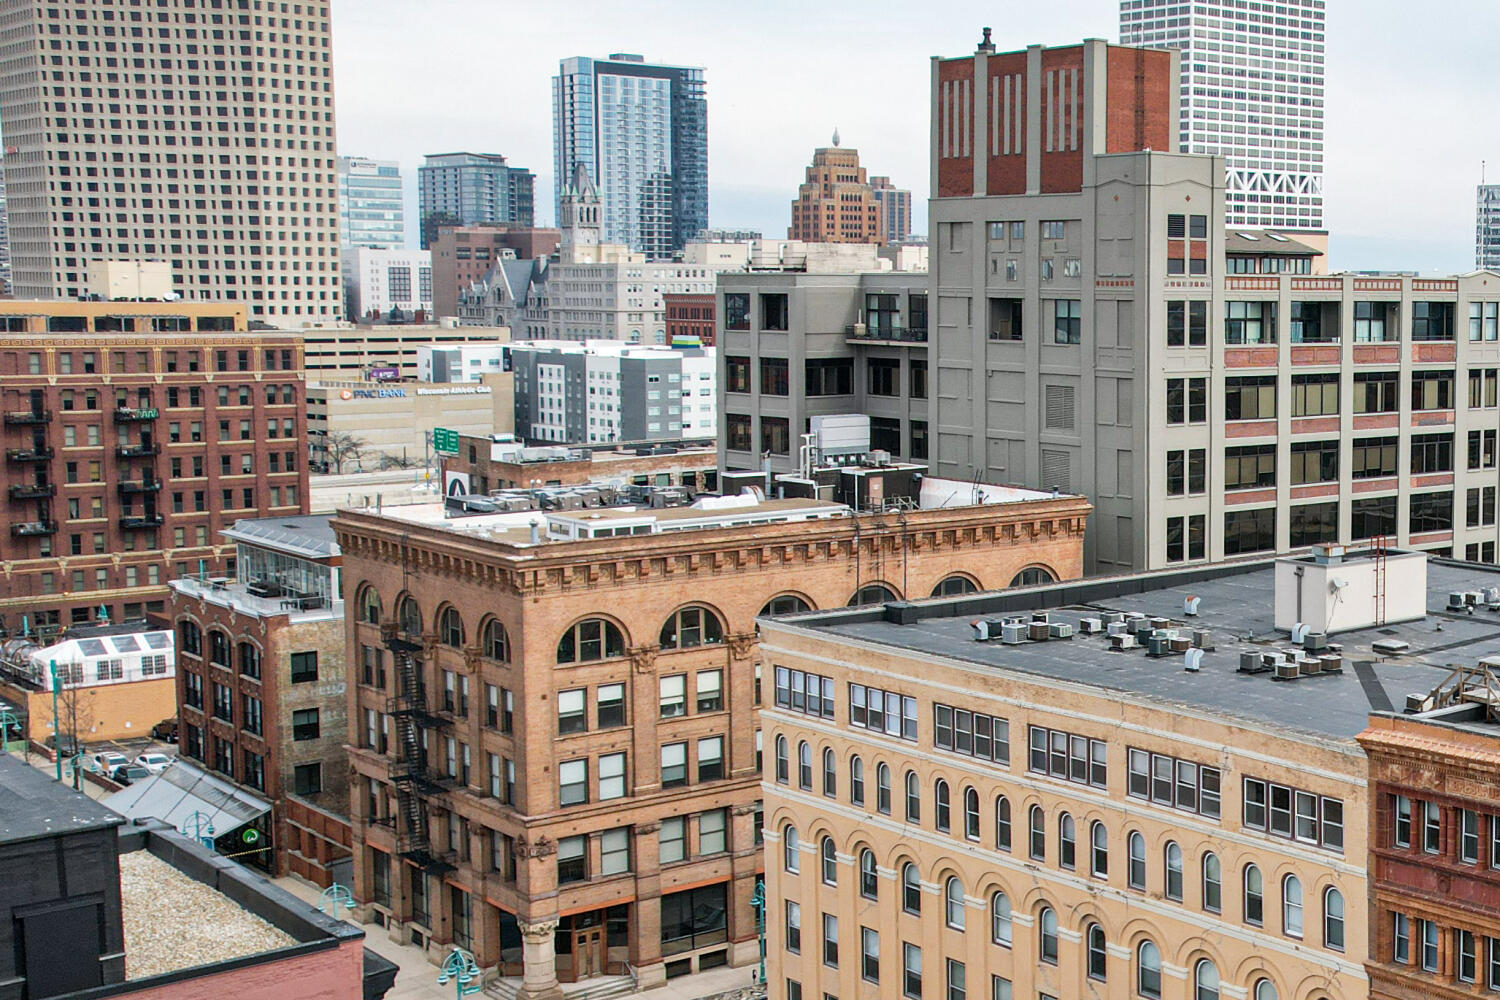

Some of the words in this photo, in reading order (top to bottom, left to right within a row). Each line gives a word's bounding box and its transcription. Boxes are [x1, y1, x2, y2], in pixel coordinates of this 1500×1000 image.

[353, 390, 377, 399] PNC
[379, 389, 407, 398] BANK
[451, 386, 476, 394] Athletic
